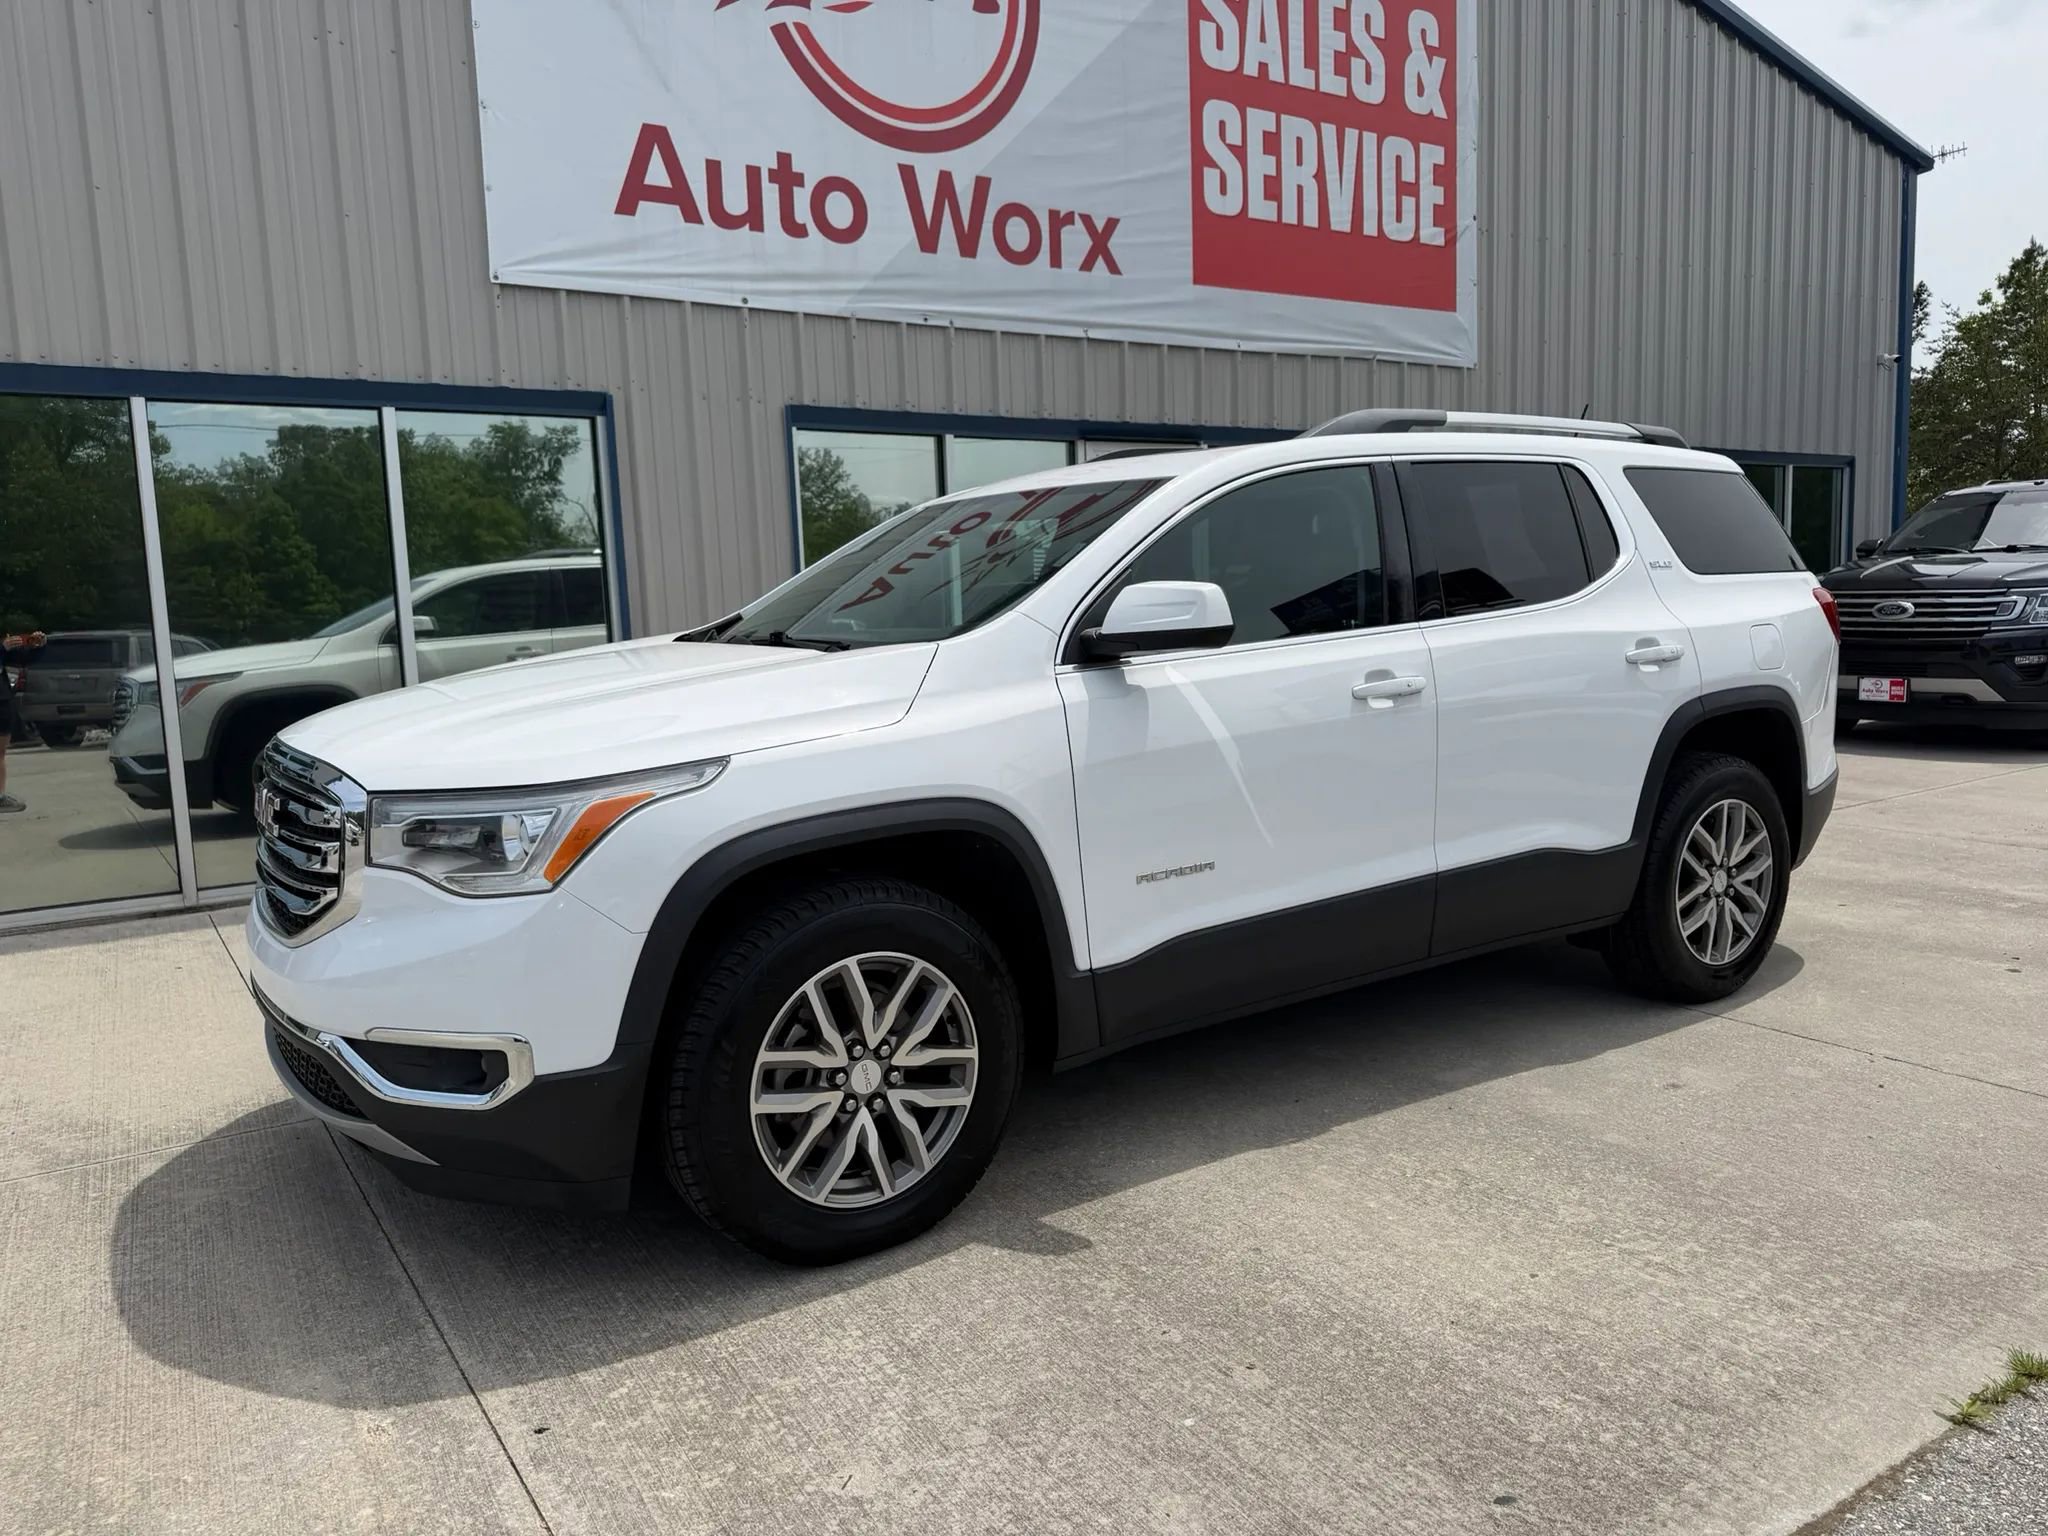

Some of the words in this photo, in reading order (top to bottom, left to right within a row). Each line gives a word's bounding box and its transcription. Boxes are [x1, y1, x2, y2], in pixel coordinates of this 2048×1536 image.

[1199, 0, 1386, 105] SALES
[1404, 9, 1449, 119] &
[613, 122, 869, 245] Auto
[896, 162, 1123, 276] Worx
[1202, 98, 1446, 247] SERVICE
[1135, 860, 1216, 886] ACADIA
[861, 1063, 873, 1092] GMC
